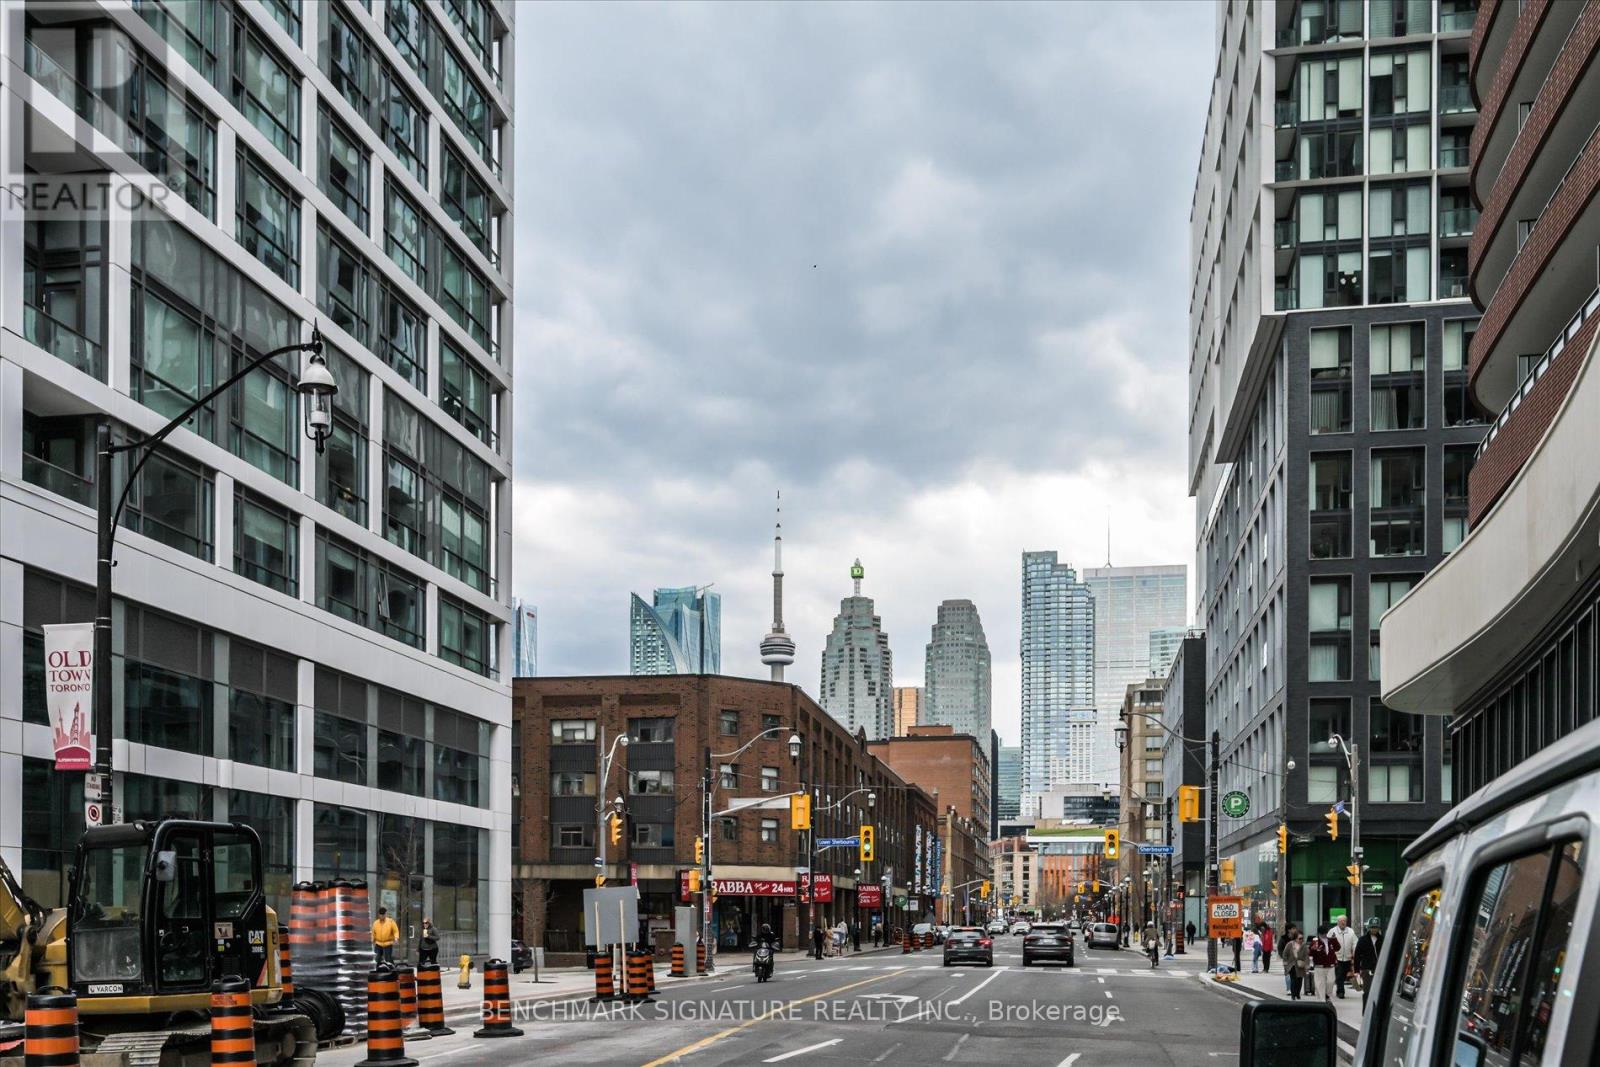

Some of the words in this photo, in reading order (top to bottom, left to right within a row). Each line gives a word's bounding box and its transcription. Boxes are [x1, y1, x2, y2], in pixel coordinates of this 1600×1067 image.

[48, 650, 92, 668] OLD
[48, 669, 91, 682] TOWN
[801, 875, 831, 883] RBBA
[248, 930, 265, 944] CAT
[96, 985, 122, 993] VARCON
